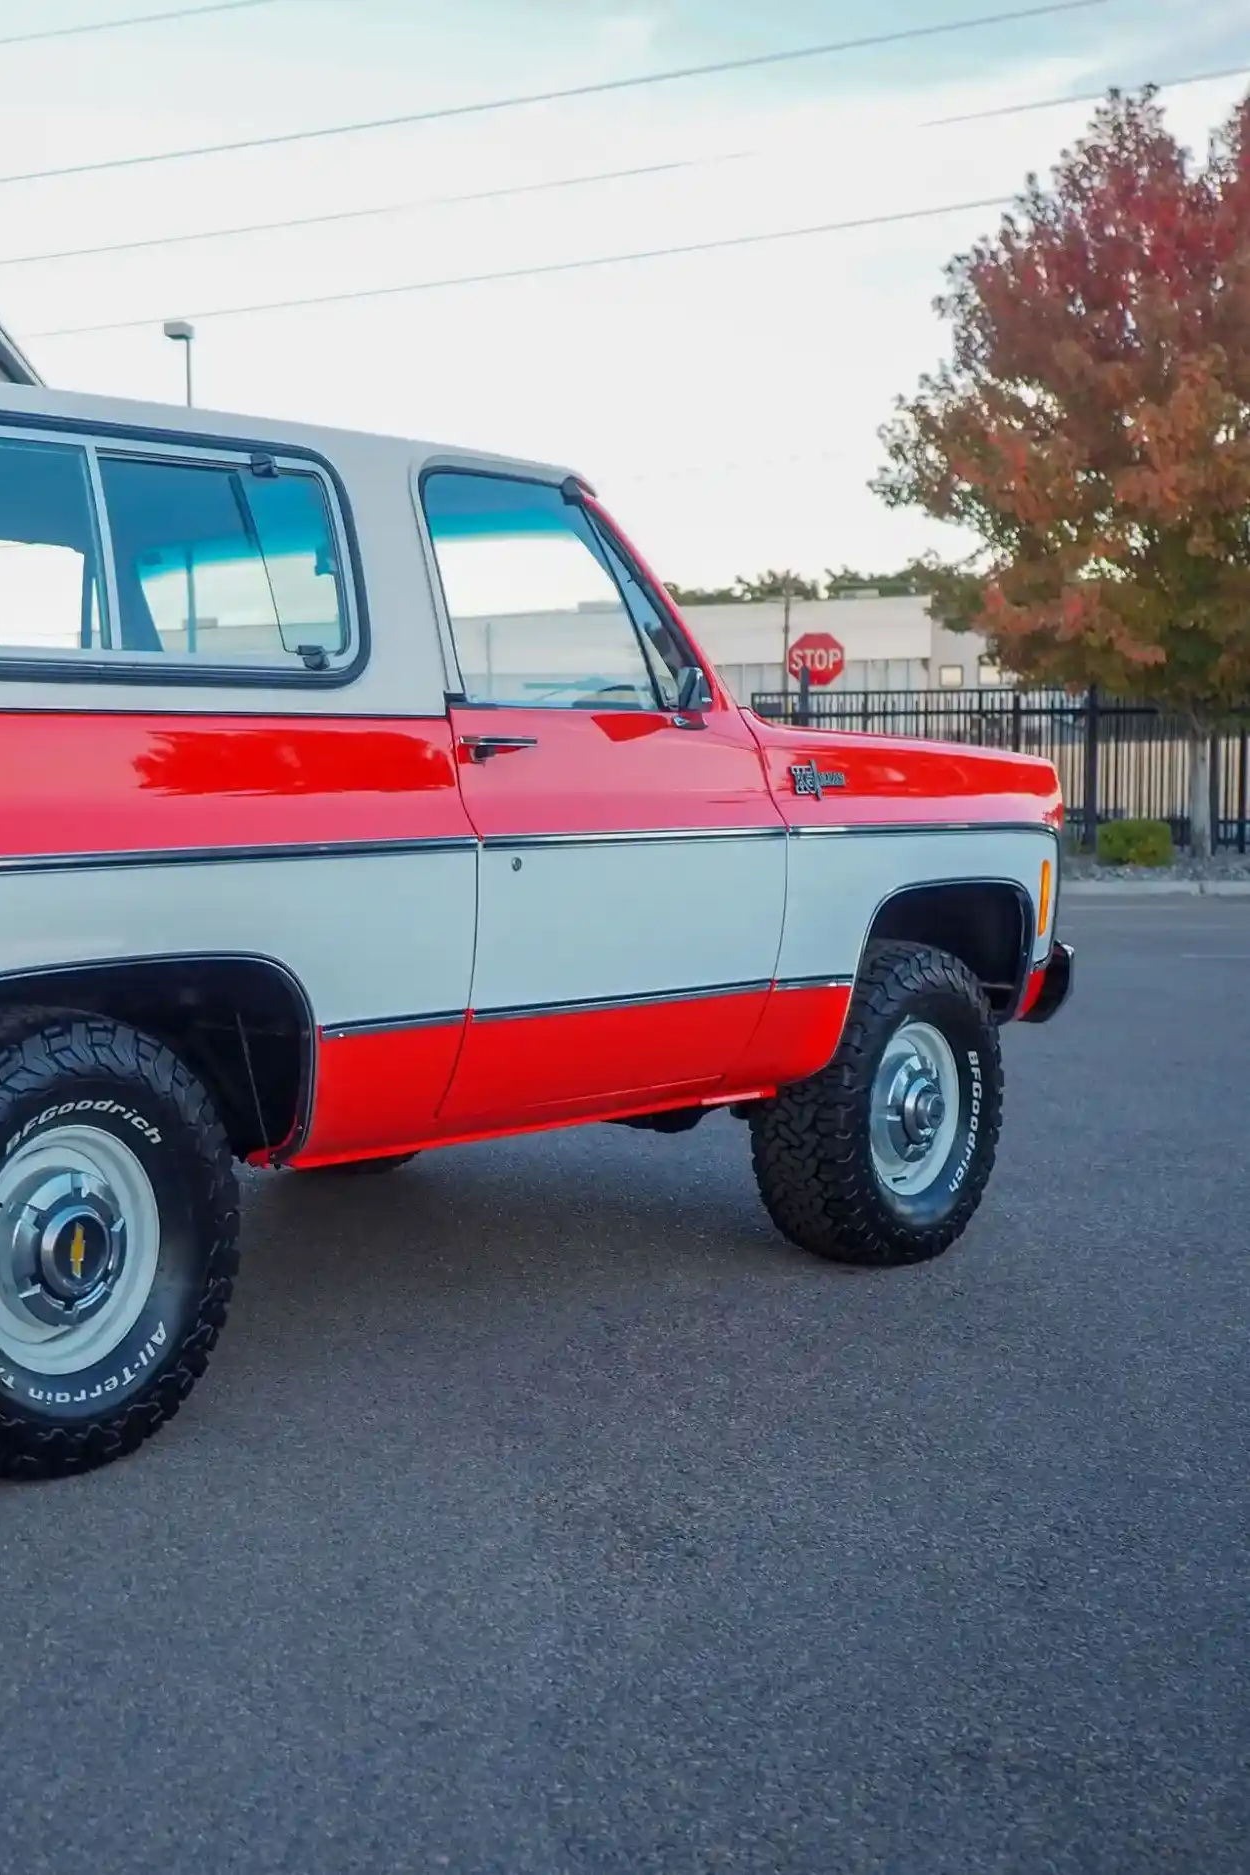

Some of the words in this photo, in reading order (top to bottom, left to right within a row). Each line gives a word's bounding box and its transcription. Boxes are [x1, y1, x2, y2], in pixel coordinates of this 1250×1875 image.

[791, 648, 842, 671] STOP
[5, 1099, 163, 1156] BFGoodrich
[948, 1050, 983, 1193] BFGoodrich
[27, 1320, 167, 1405] All-Terrain
